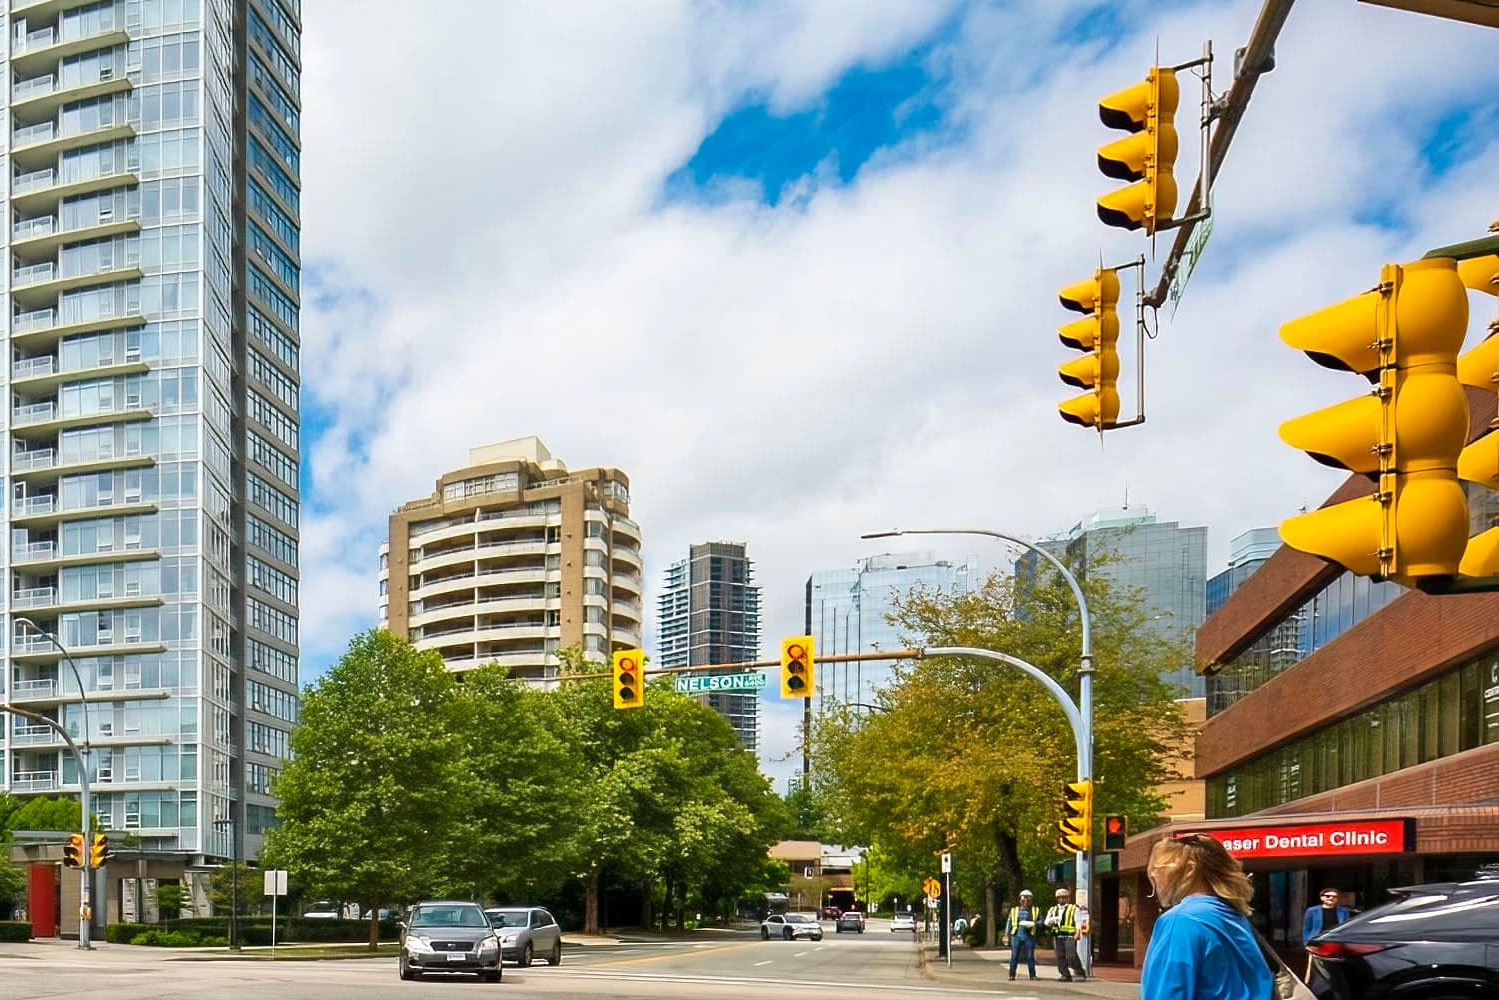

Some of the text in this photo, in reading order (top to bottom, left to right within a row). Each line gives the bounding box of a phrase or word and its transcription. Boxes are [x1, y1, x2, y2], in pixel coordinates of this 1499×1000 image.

[677, 676, 743, 691] NELSON
[1222, 830, 1387, 850] aser Dental Clinic
